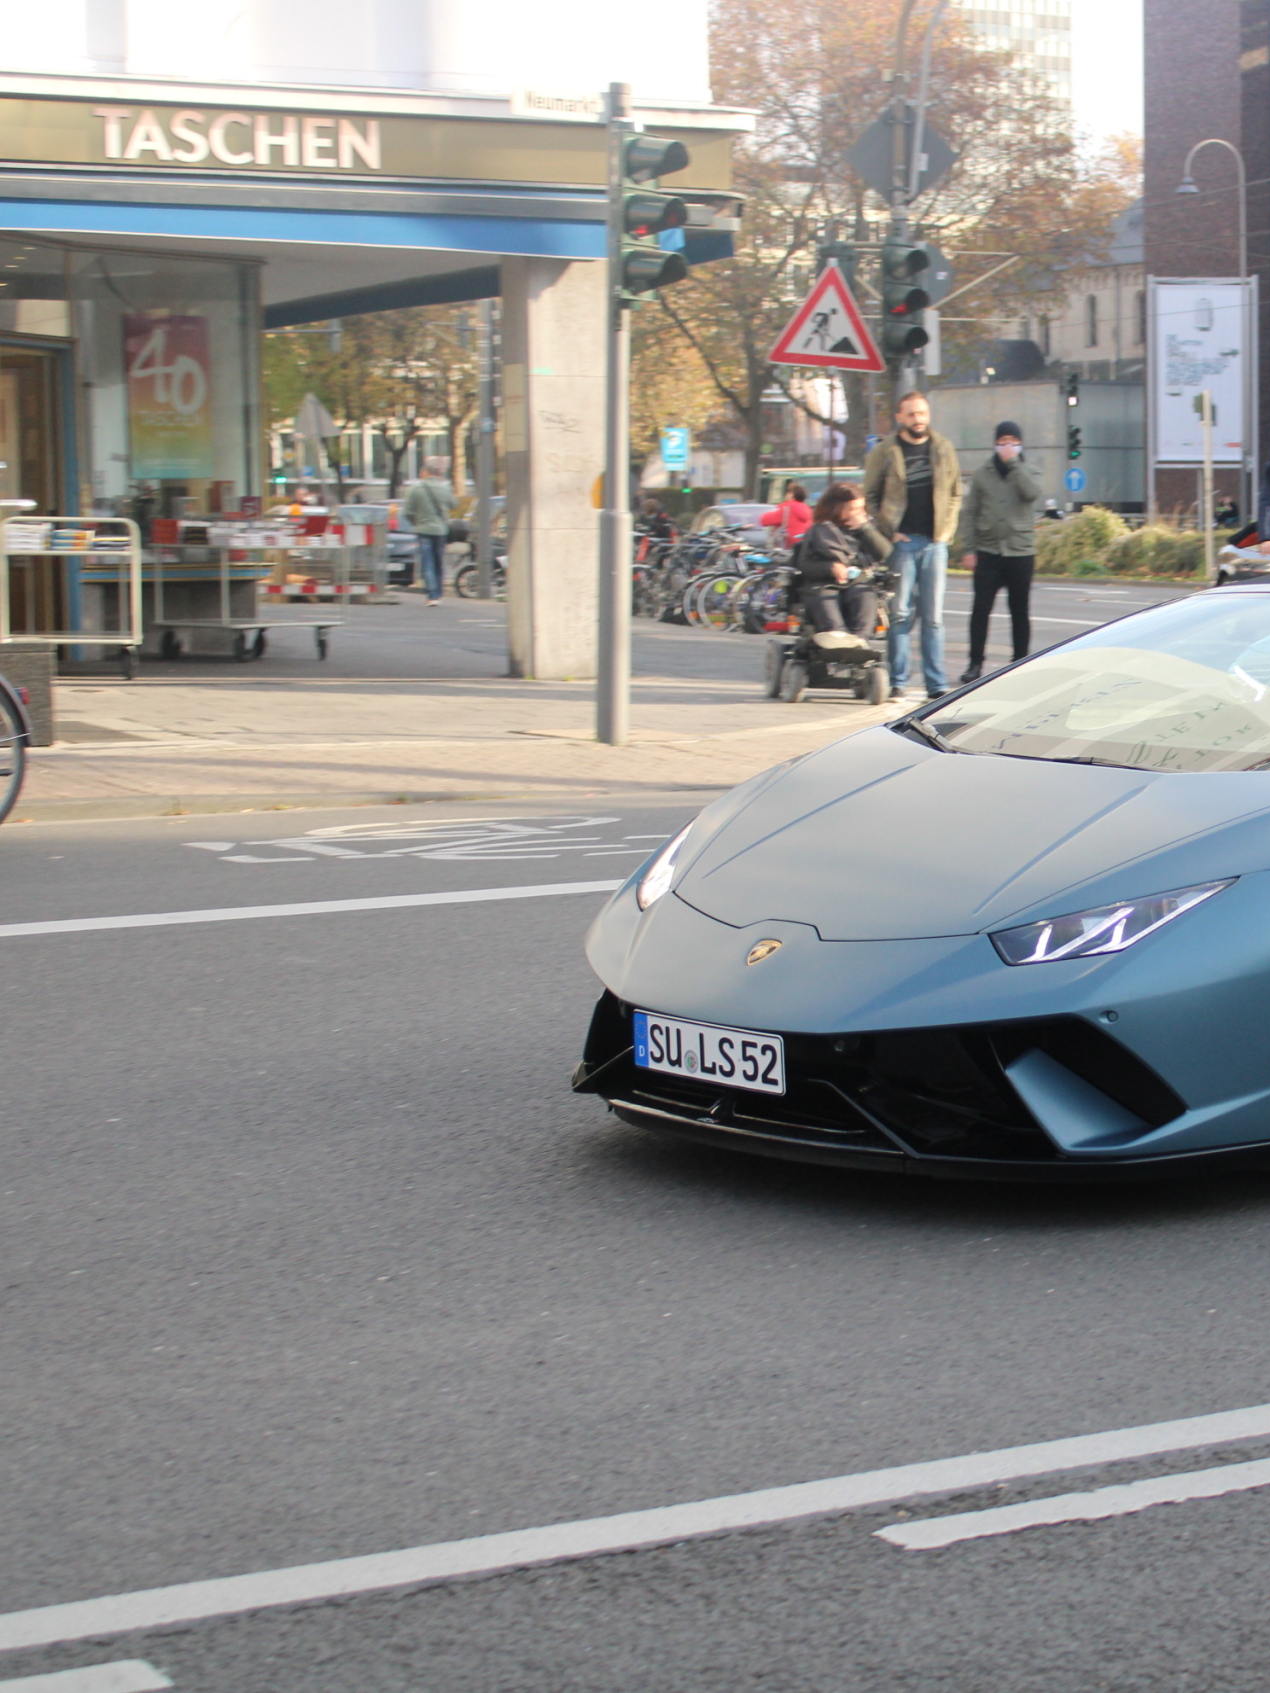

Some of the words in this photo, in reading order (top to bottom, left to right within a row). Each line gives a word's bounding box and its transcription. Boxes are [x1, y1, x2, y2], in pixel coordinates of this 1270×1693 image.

[94, 107, 381, 170] TASCHEN
[129, 327, 207, 415] 40
[638, 1045, 646, 1057] D
[649, 1023, 683, 1069] SU
[741, 1039, 779, 1087] 52
